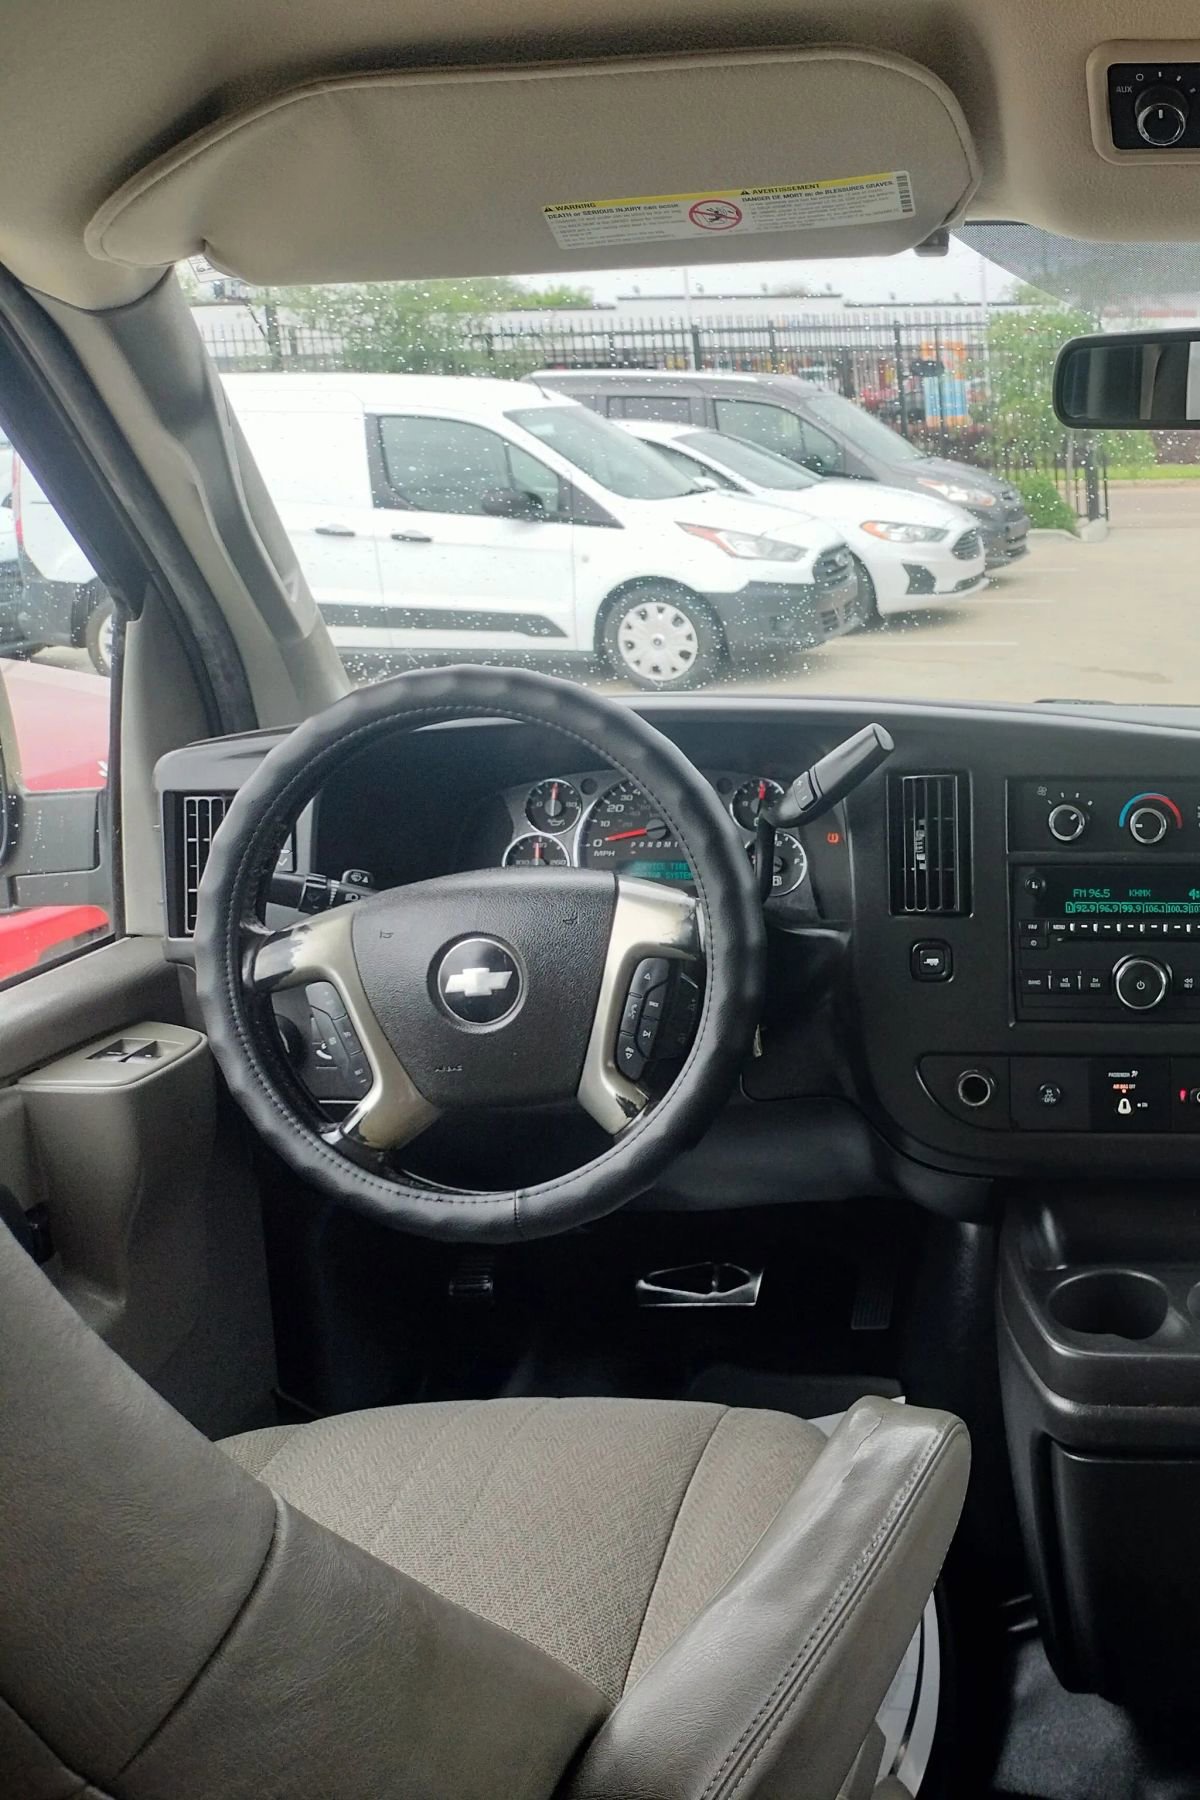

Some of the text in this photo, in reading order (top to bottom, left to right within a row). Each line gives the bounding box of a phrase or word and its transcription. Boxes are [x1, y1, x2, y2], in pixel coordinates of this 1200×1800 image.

[752, 183, 820, 195] AVERTISSEMENT
[555, 202, 597, 212] WARNING
[583, 208, 614, 216] SERIOUS
[606, 804, 624, 813] 20
[593, 839, 603, 847] 0
[1073, 889, 1087, 898] FM
[1088, 889, 1111, 898] 96.5
[1128, 889, 1151, 897] KHMX
[1076, 904, 1096, 913] 92.9
[1145, 904, 1166, 913] 106.1
